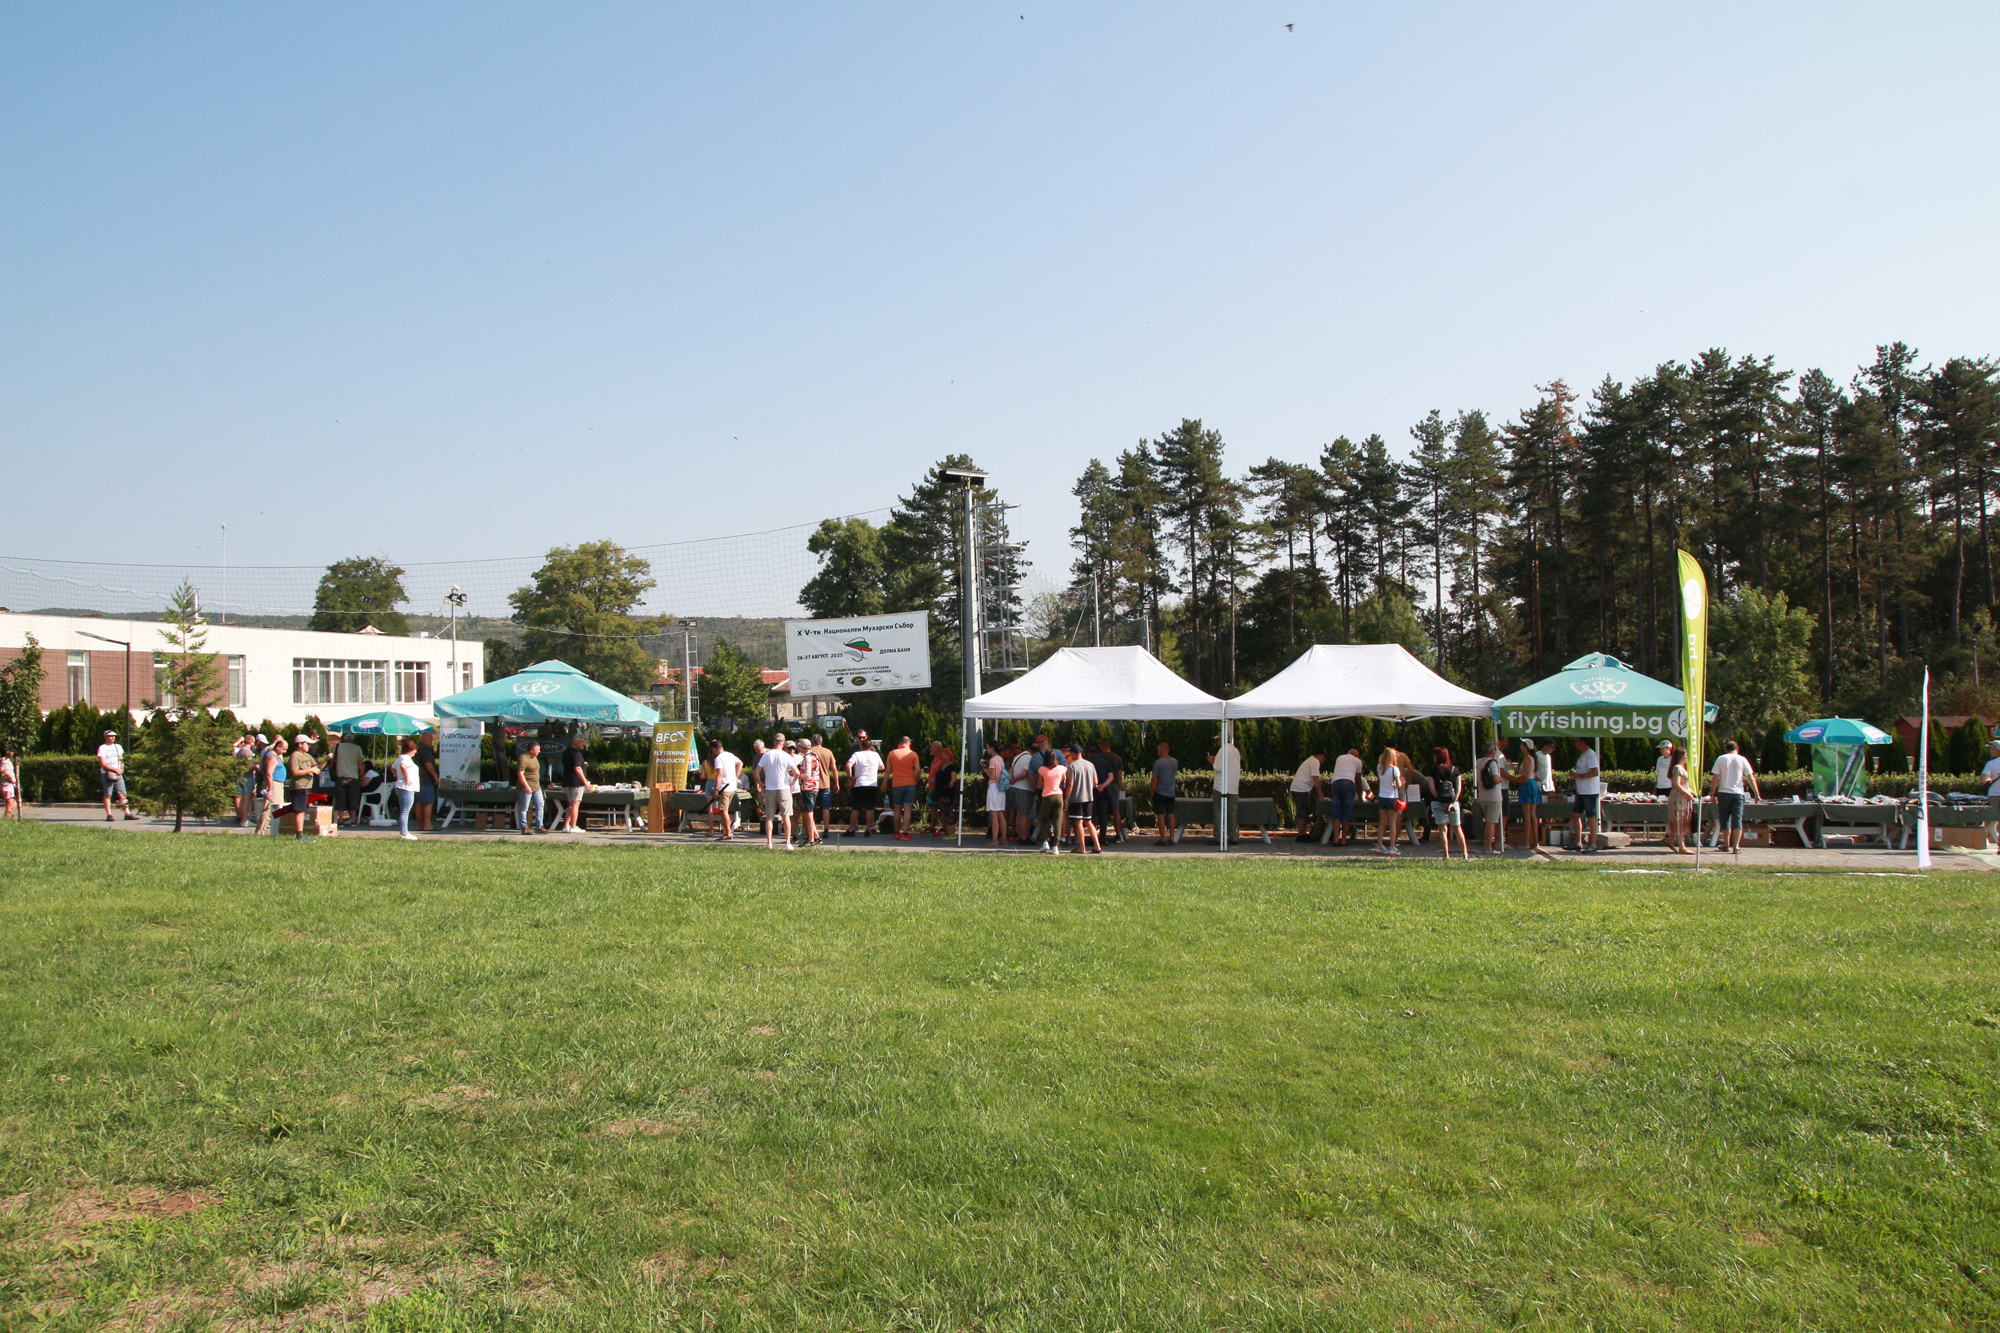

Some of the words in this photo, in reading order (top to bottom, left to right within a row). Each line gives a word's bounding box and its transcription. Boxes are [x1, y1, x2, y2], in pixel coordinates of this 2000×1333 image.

[823, 627, 861, 635] Национален
[862, 624, 894, 633] Мухарски
[894, 622, 914, 630] Събор
[1507, 711, 1663, 735] flyfishing.bg
[655, 732, 679, 742] BFC
